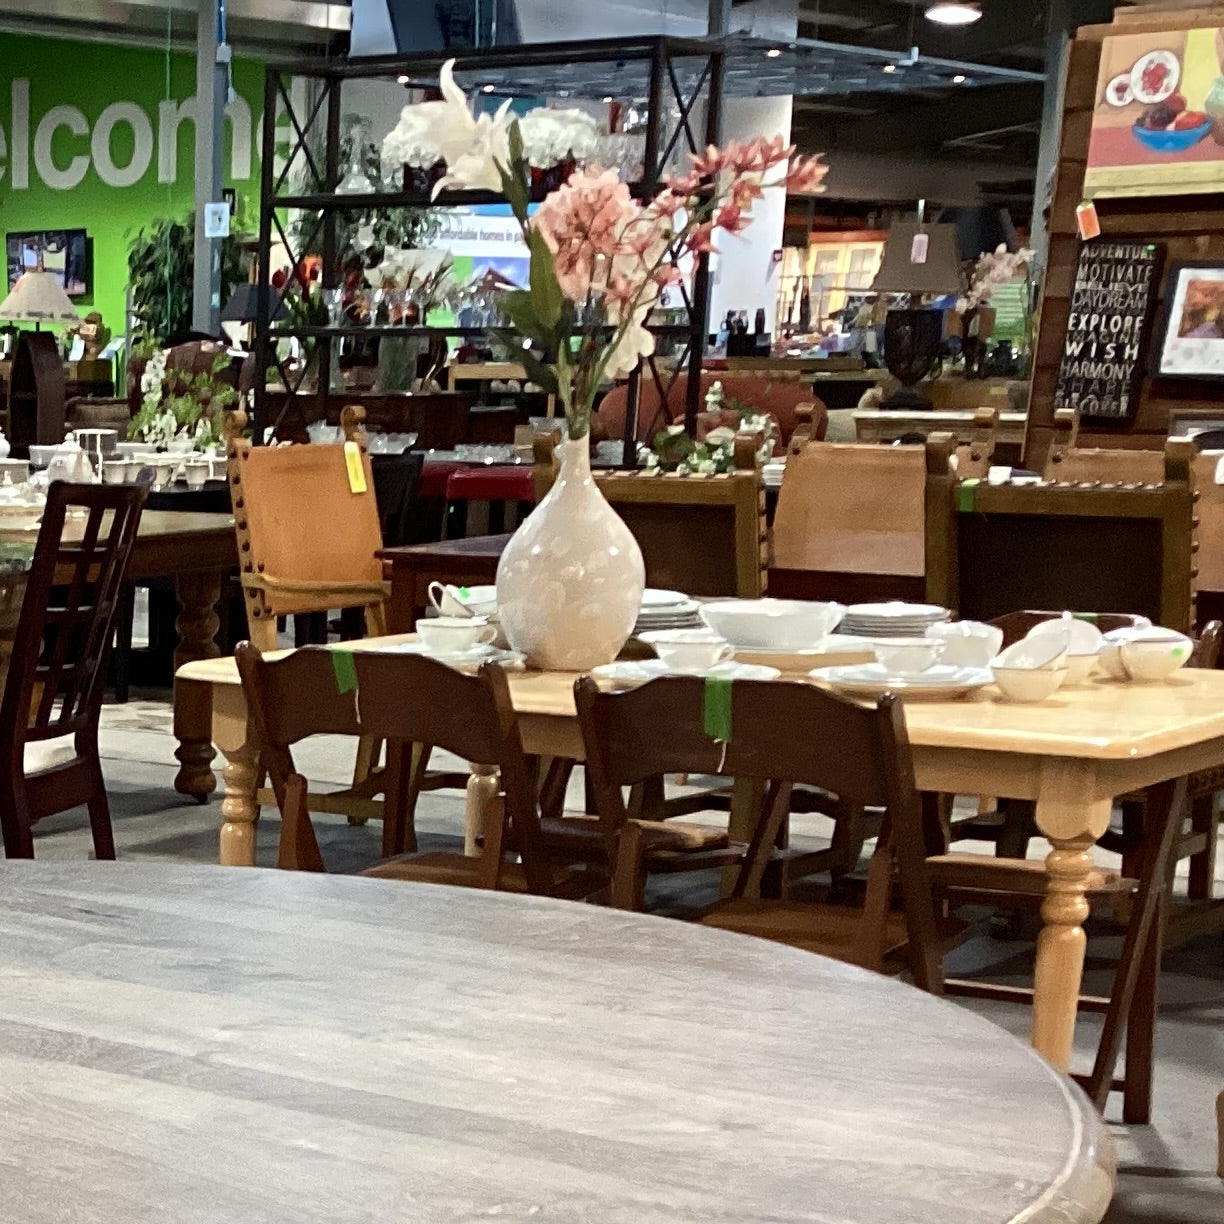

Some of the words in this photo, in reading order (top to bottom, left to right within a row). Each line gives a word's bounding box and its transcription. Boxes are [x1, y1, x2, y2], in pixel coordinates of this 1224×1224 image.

[479, 227, 504, 241] homes
[1077, 263, 1154, 283] MOTIVATE
[1067, 312, 1145, 334] EXPLORE
[1065, 340, 1140, 361] WISH
[1060, 360, 1135, 380] HARMONY
